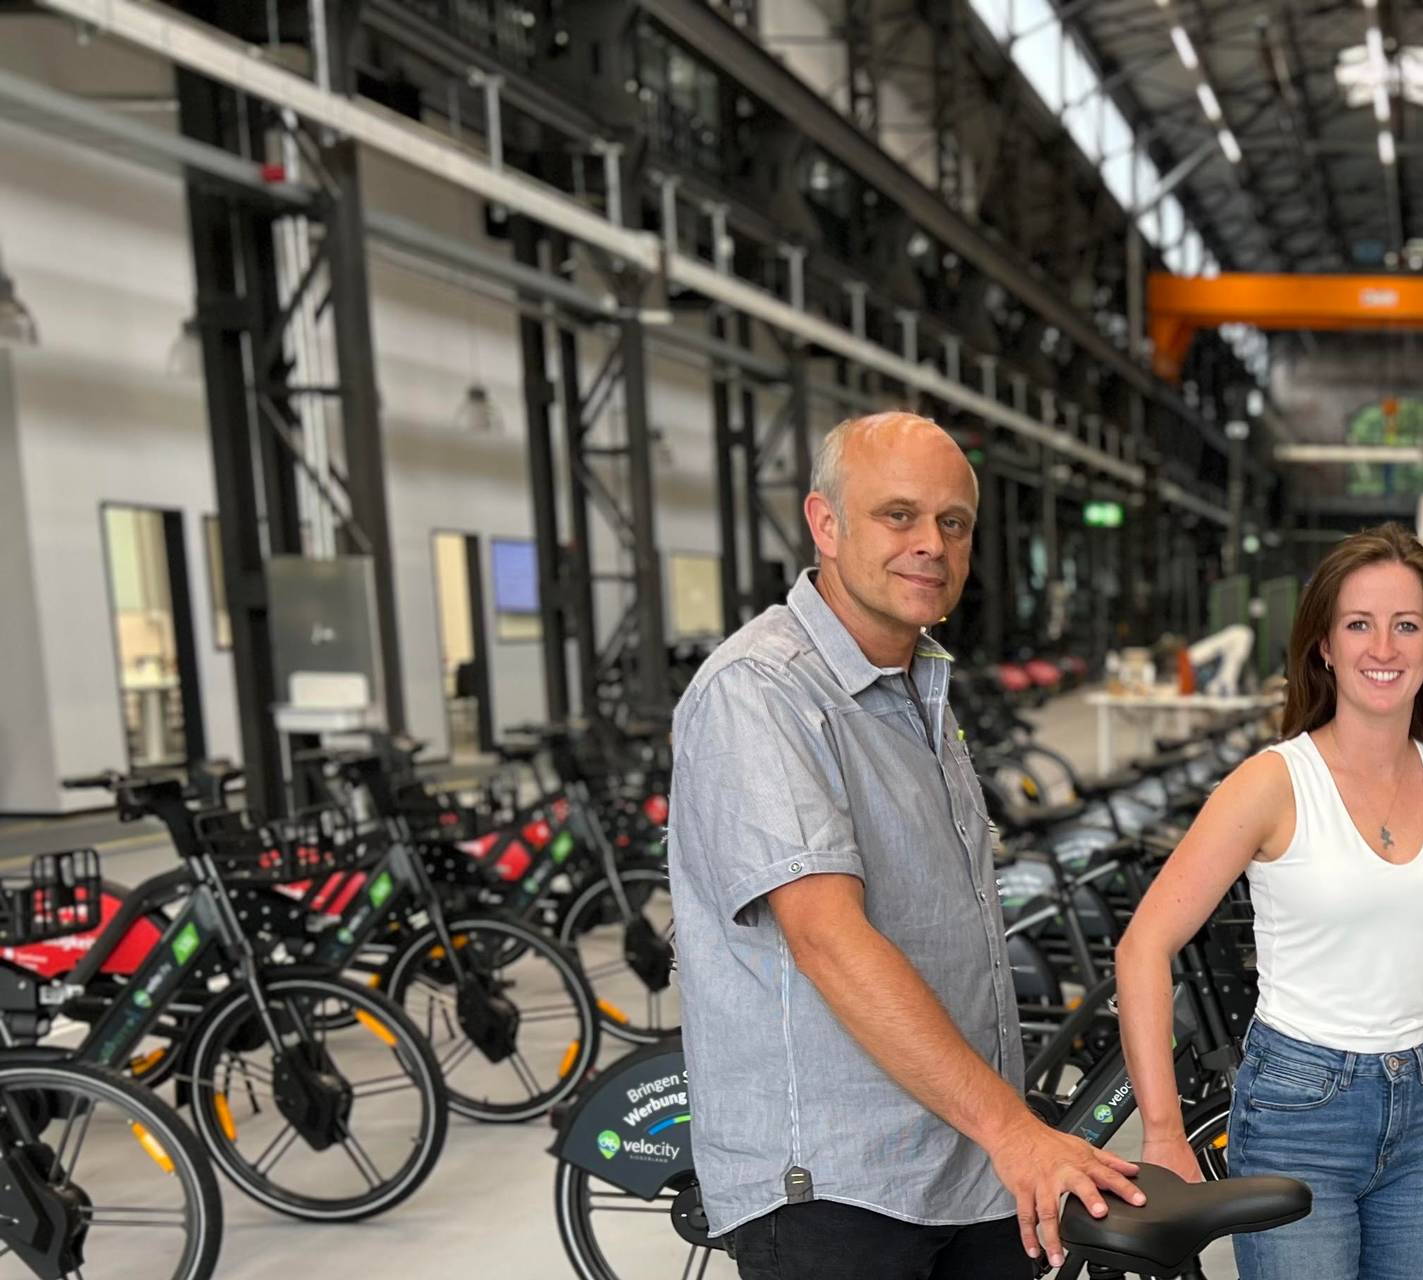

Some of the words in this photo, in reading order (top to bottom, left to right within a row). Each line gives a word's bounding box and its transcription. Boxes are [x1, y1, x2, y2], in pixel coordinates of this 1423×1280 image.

[626, 1074, 680, 1103] Bringen
[623, 1091, 688, 1127] Werbung
[622, 1138, 680, 1160] velocity
